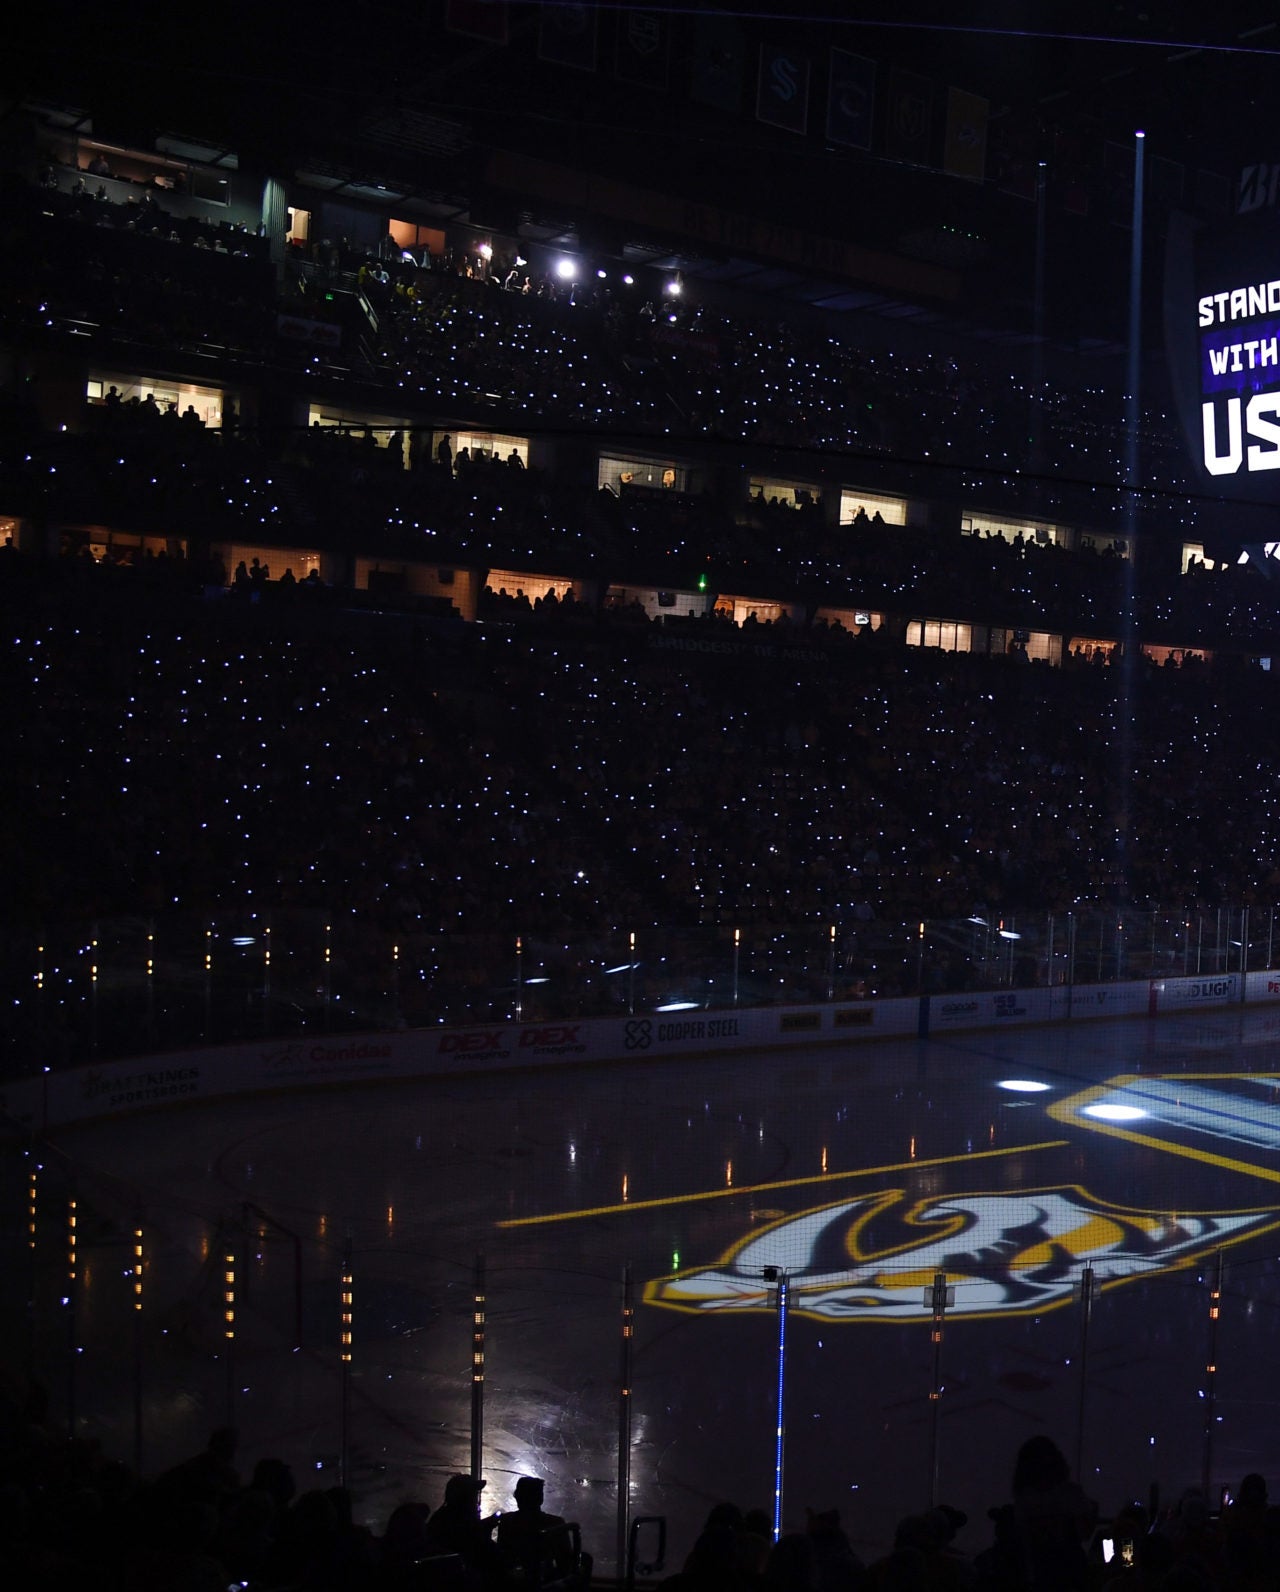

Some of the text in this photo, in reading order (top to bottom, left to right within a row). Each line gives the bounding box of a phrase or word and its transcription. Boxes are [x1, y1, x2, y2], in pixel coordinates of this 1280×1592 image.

[1209, 337, 1278, 376] WITH
[649, 634, 777, 658] BRIDGESTNE
[437, 1030, 504, 1053] DEX
[519, 1025, 581, 1048] DEX
[658, 1018, 739, 1042] COOPER STEEL
